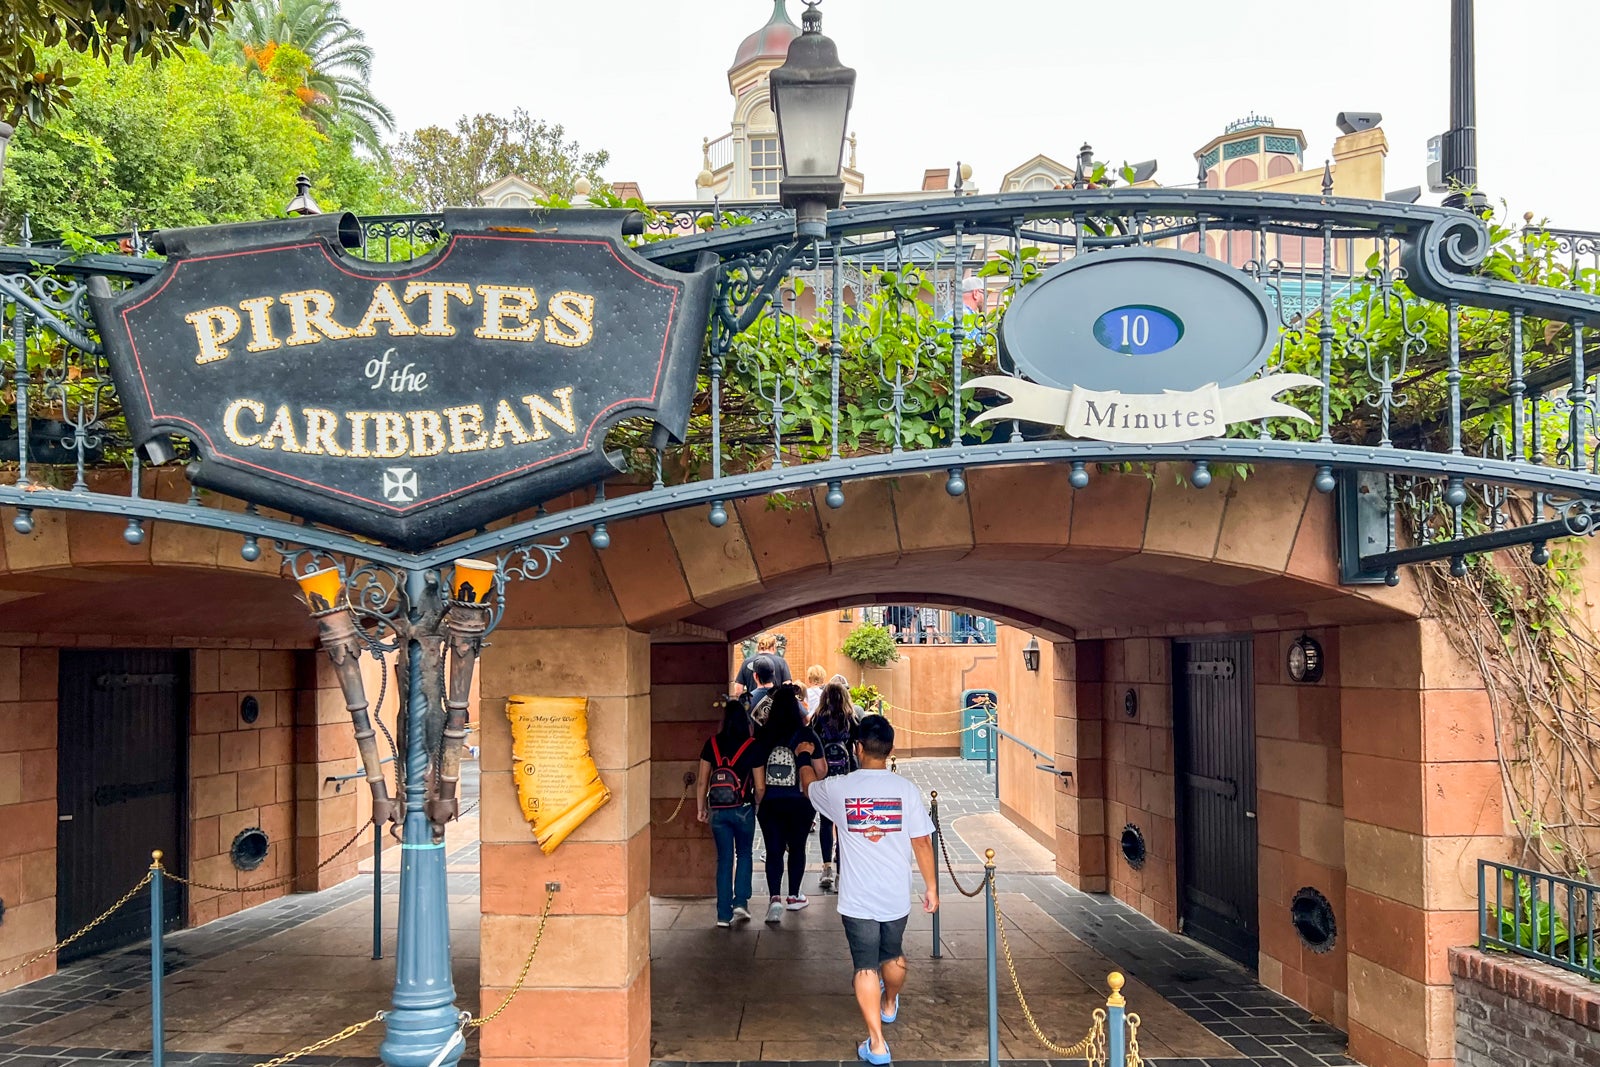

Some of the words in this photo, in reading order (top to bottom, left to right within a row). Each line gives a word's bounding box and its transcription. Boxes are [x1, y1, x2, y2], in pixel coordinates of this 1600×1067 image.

[184, 281, 595, 365] PIRATES
[1120, 314, 1150, 347] 10
[364, 347, 396, 390] of
[389, 362, 429, 393] the
[223, 386, 576, 458] CARIBBEAN
[1083, 400, 1216, 430] Minutes
[530, 715, 548, 723] May
[549, 715, 561, 723] Get
